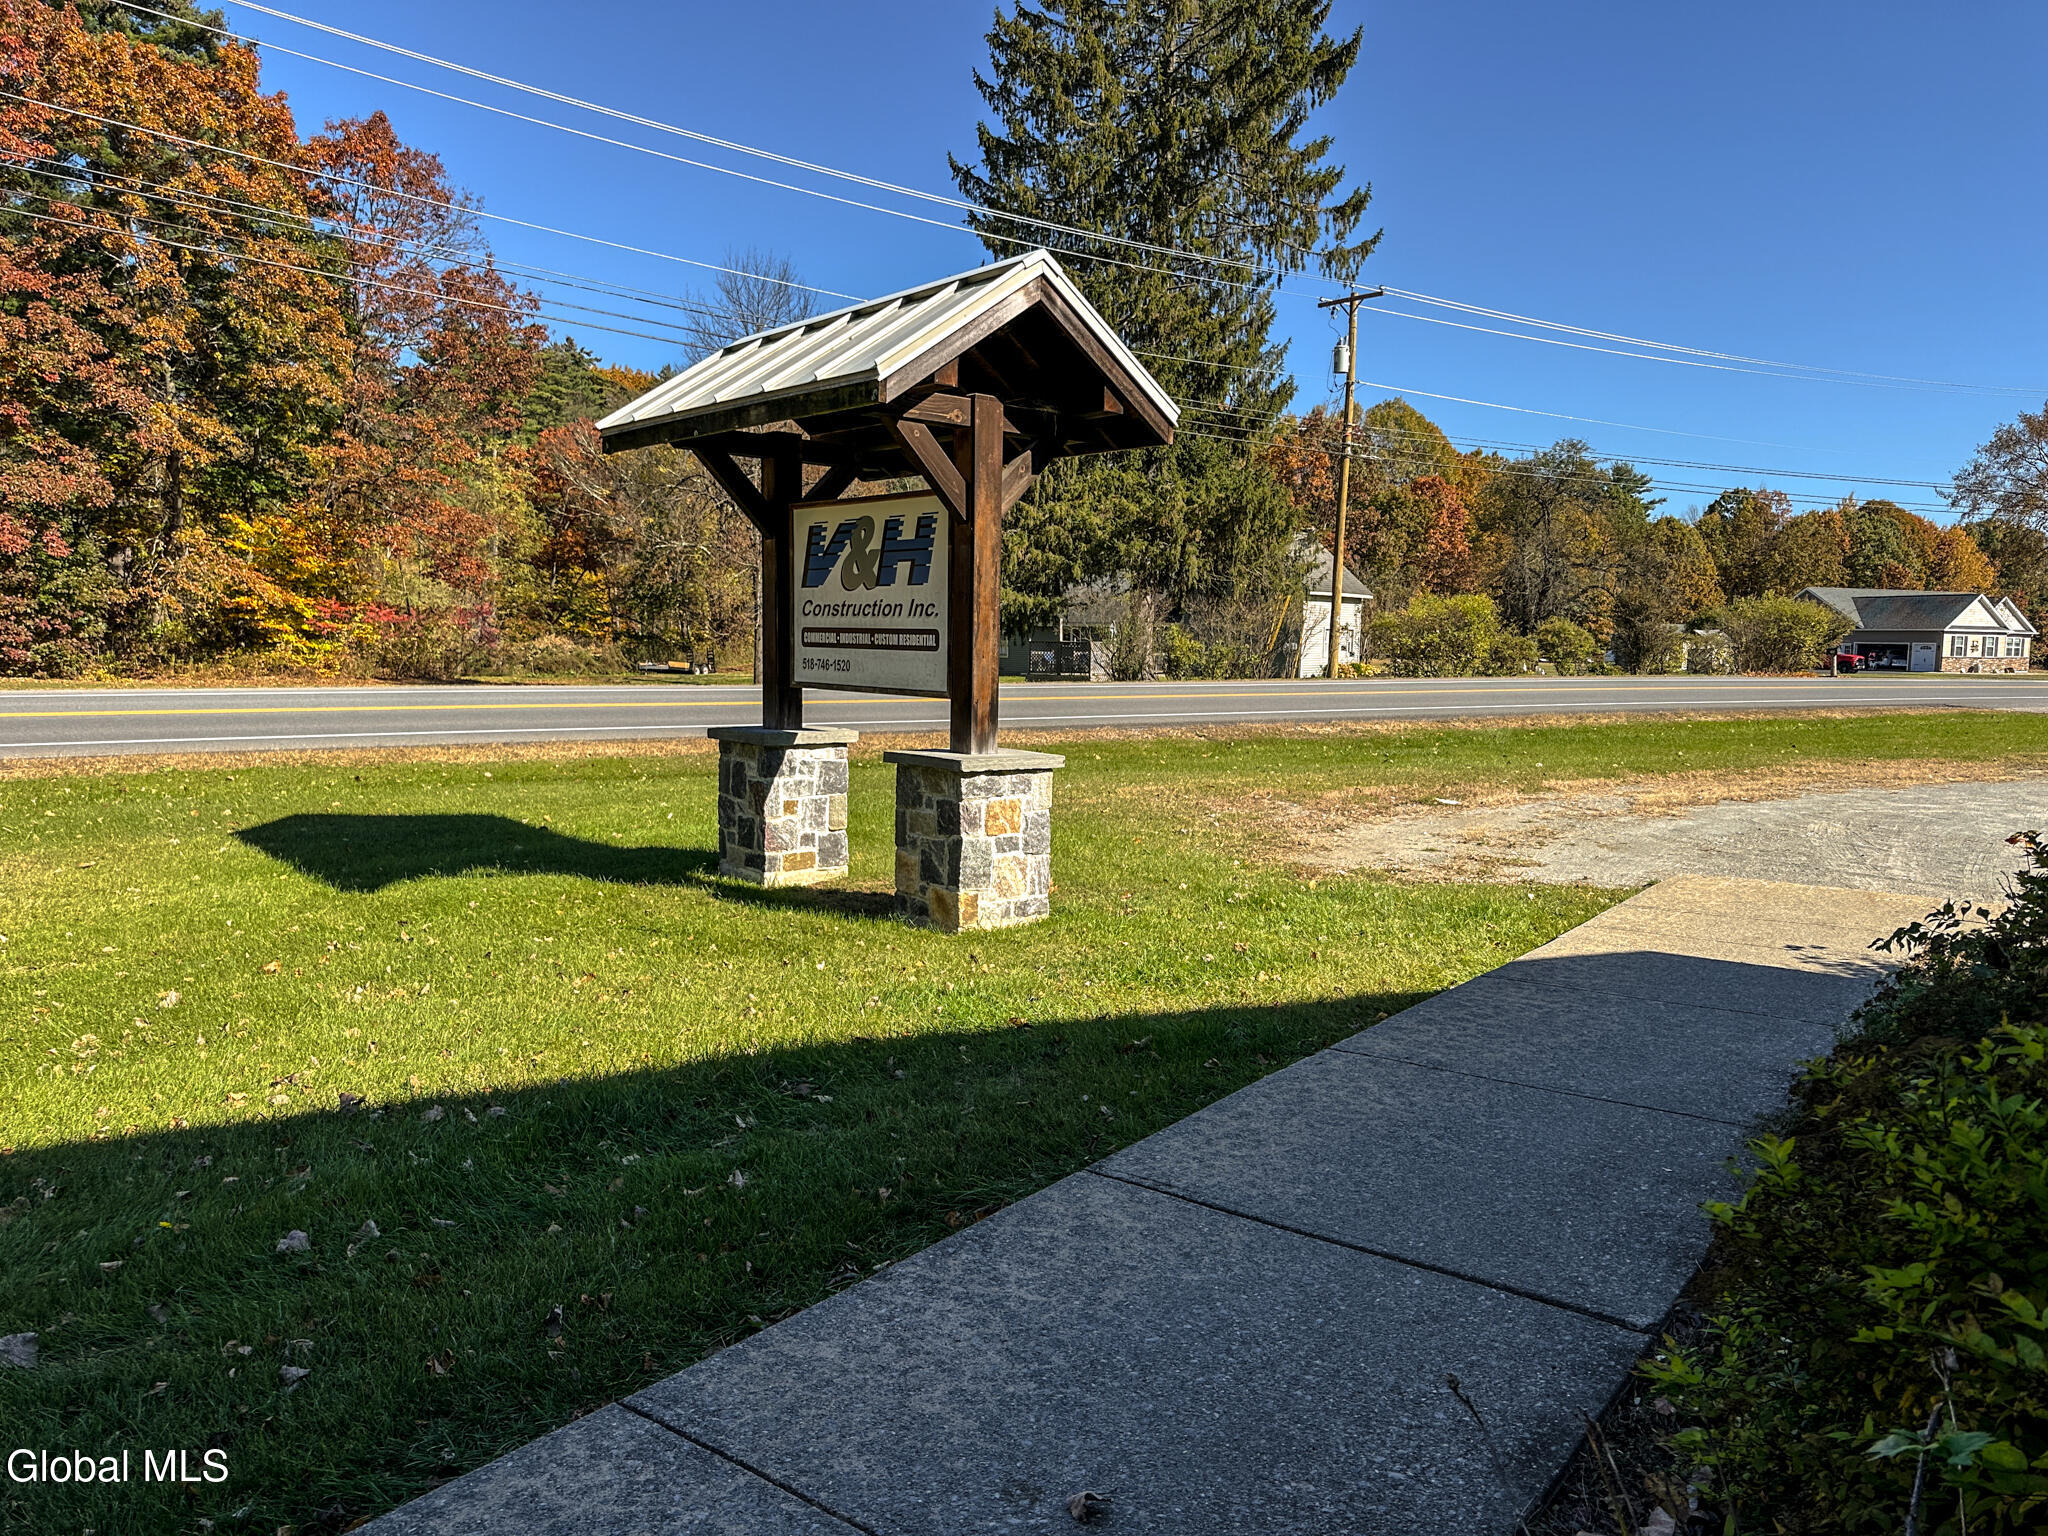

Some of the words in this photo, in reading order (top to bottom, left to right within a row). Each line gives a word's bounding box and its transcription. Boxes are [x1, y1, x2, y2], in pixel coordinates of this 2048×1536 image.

[801, 512, 939, 591] V&H
[802, 599, 903, 617] Construction
[907, 599, 939, 617] Inc.
[803, 632, 837, 644] COMMERCIAL
[839, 633, 872, 645] INDUSTRIAL
[874, 634, 898, 646] CUSTOM
[899, 634, 937, 647] RESIDENTIAL
[802, 657, 851, 672] 518-746-1520
